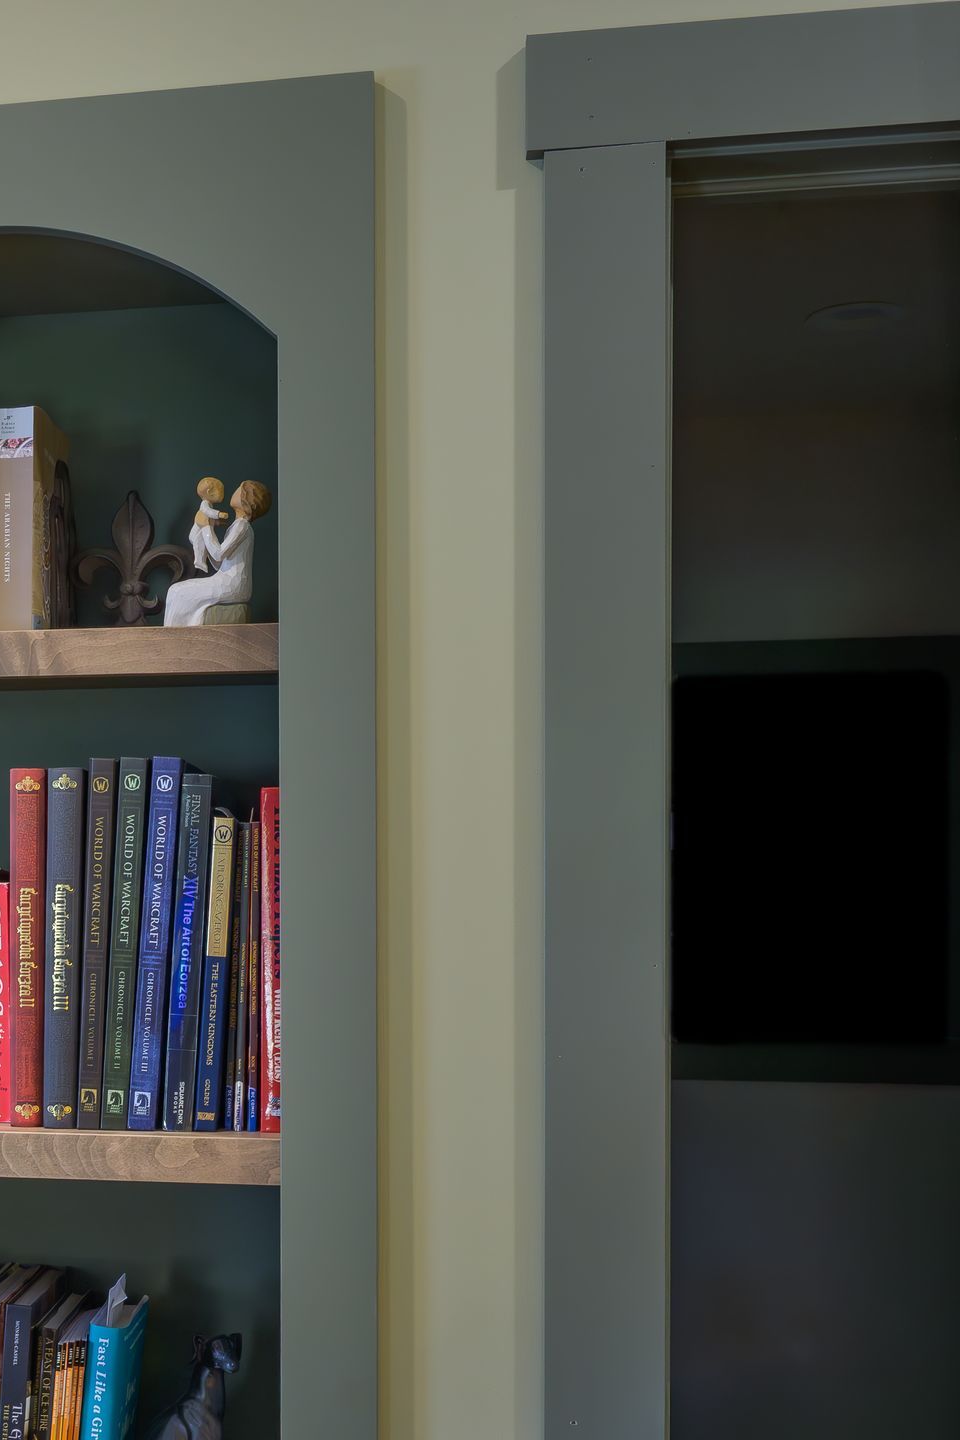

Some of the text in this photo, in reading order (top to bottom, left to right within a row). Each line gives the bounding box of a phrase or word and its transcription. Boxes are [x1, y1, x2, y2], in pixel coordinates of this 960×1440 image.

[183, 793, 201, 900] FINAL FANTASY XIV
[90, 816, 104, 947] WORLD OF WARCRAFT
[119, 814, 136, 946] WORLD OF WARCRAFT
[149, 815, 167, 946] WORLD OF WARCRAFT
[178, 902, 194, 1009] The Art of Eorzea
[211, 962, 219, 981] THE
[20, 998, 35, 1007] II
[53, 995, 69, 1010] III
[209, 983, 218, 1022] EASTERN
[205, 1022, 216, 1066] KINGDOMS
[97, 1337, 109, 1367] Fast
[93, 1370, 109, 1404] Like
[11, 1402, 23, 1425] The
[93, 1405, 101, 1415] a
